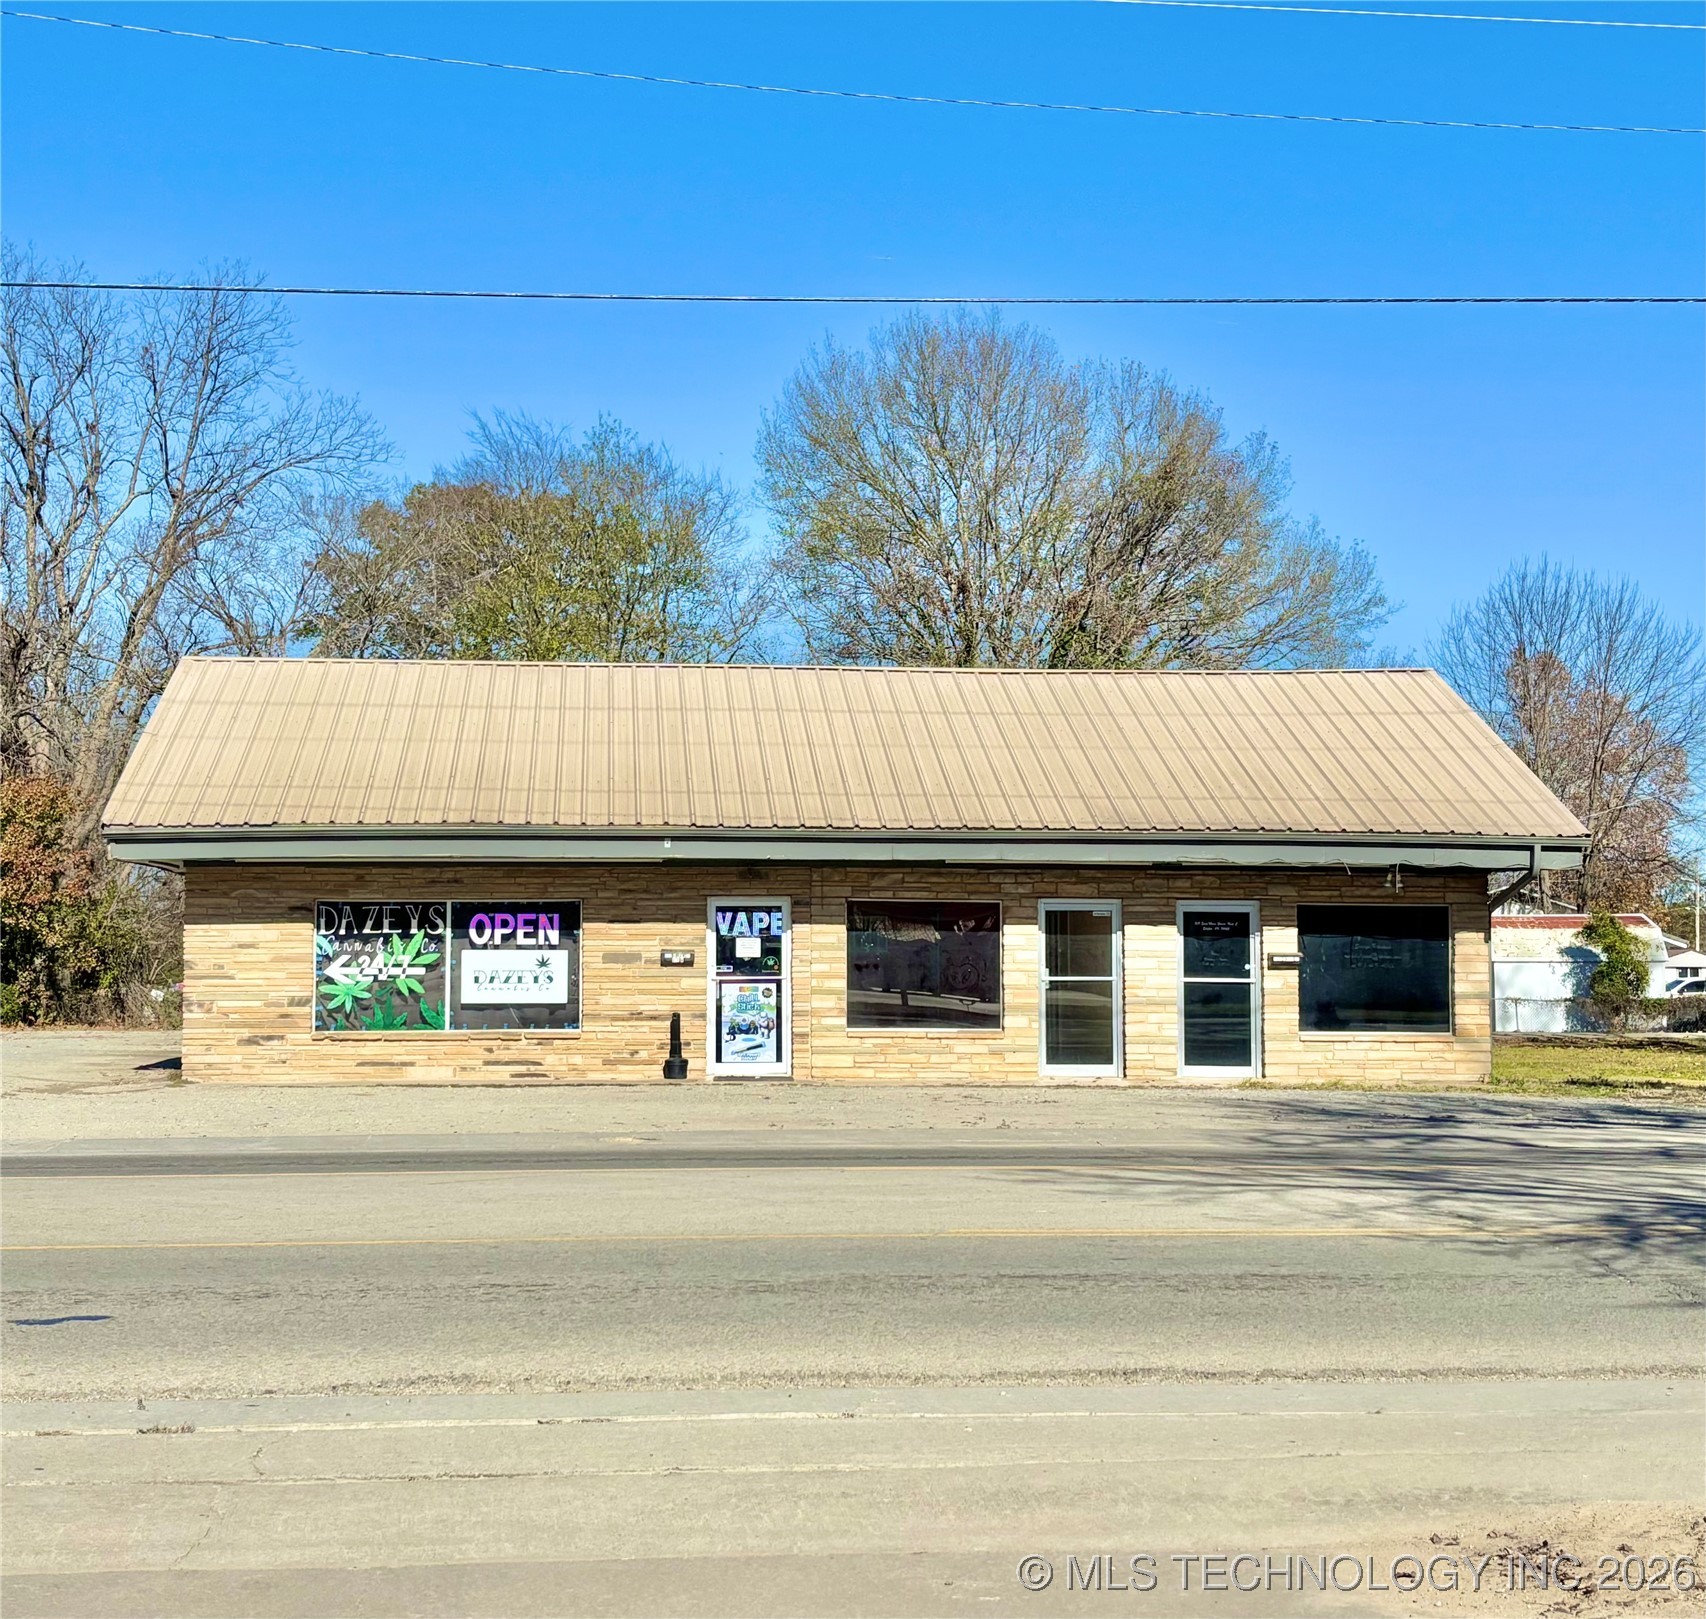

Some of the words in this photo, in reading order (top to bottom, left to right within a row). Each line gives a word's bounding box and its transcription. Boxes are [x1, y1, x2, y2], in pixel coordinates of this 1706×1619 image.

[318, 905, 445, 935] DAZEYS
[468, 913, 560, 945] OPEN
[716, 912, 783, 936] VAPE
[321, 935, 407, 956] Cannabis
[420, 938, 439, 953] Co.
[356, 952, 412, 982] 24/7
[473, 969, 554, 985] DAZEYS
